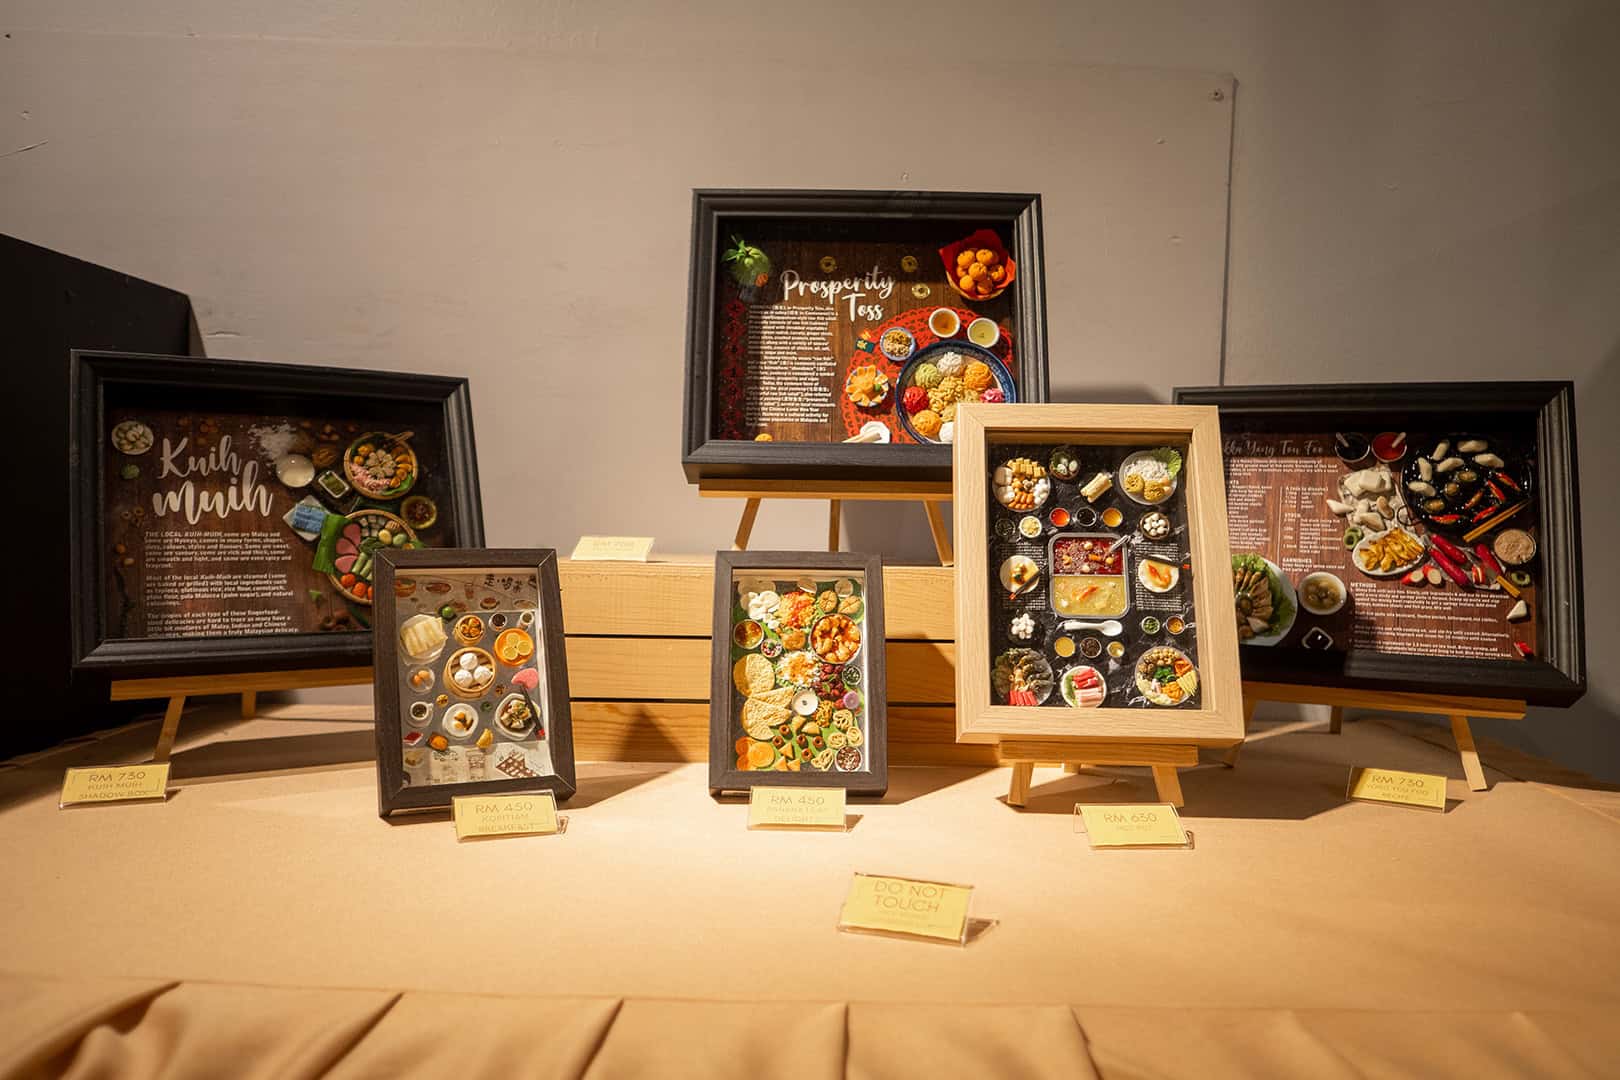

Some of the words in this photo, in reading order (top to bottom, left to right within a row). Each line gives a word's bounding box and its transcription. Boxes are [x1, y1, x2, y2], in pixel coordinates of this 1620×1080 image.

[780, 265, 895, 304] Prosperity
[842, 293, 884, 322] Toss
[158, 435, 242, 479] Kuih
[152, 461, 273, 525] Muih
[89, 774, 112, 783] RM
[119, 771, 146, 781] 730
[1371, 775, 1393, 785] RM
[1399, 777, 1425, 788] 730
[475, 804, 500, 814] RM
[504, 801, 534, 812] 450
[770, 795, 793, 805] RM
[798, 795, 825, 805] 450
[1103, 812, 1127, 824] RM
[873, 880, 904, 895] DO
[910, 885, 946, 899] NOT
[874, 894, 941, 913] TOUCH
